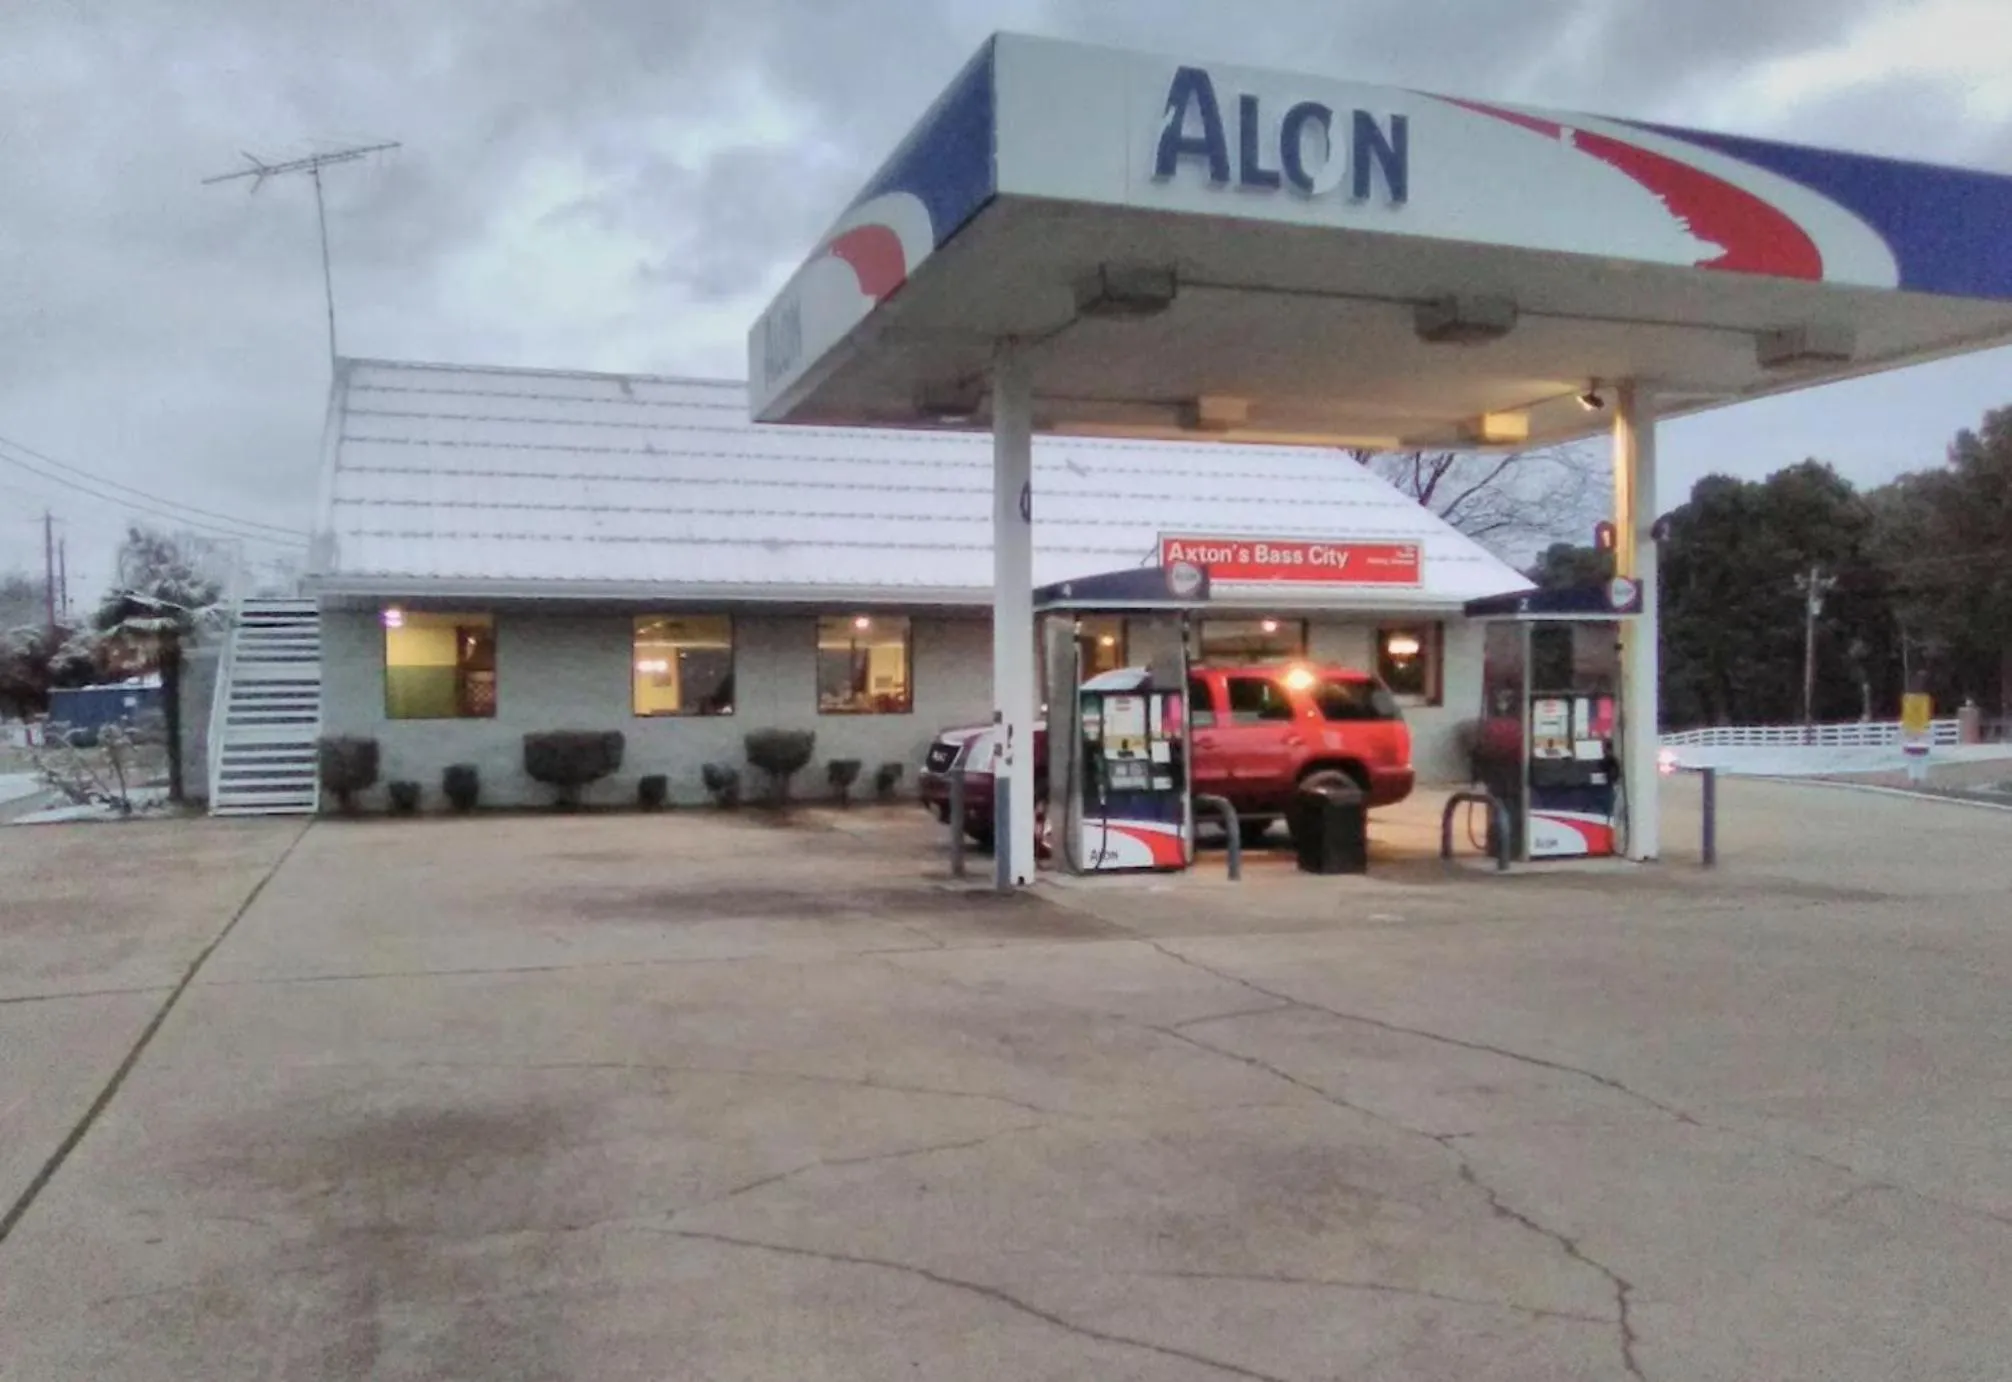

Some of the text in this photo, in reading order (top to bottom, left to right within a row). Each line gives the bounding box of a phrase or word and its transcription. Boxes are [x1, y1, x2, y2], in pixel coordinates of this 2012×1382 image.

[1154, 65, 1409, 204] ALON
[1168, 541, 1249, 563] Axton's
[1254, 544, 1303, 564] Bass
[1309, 546, 1349, 569] City
